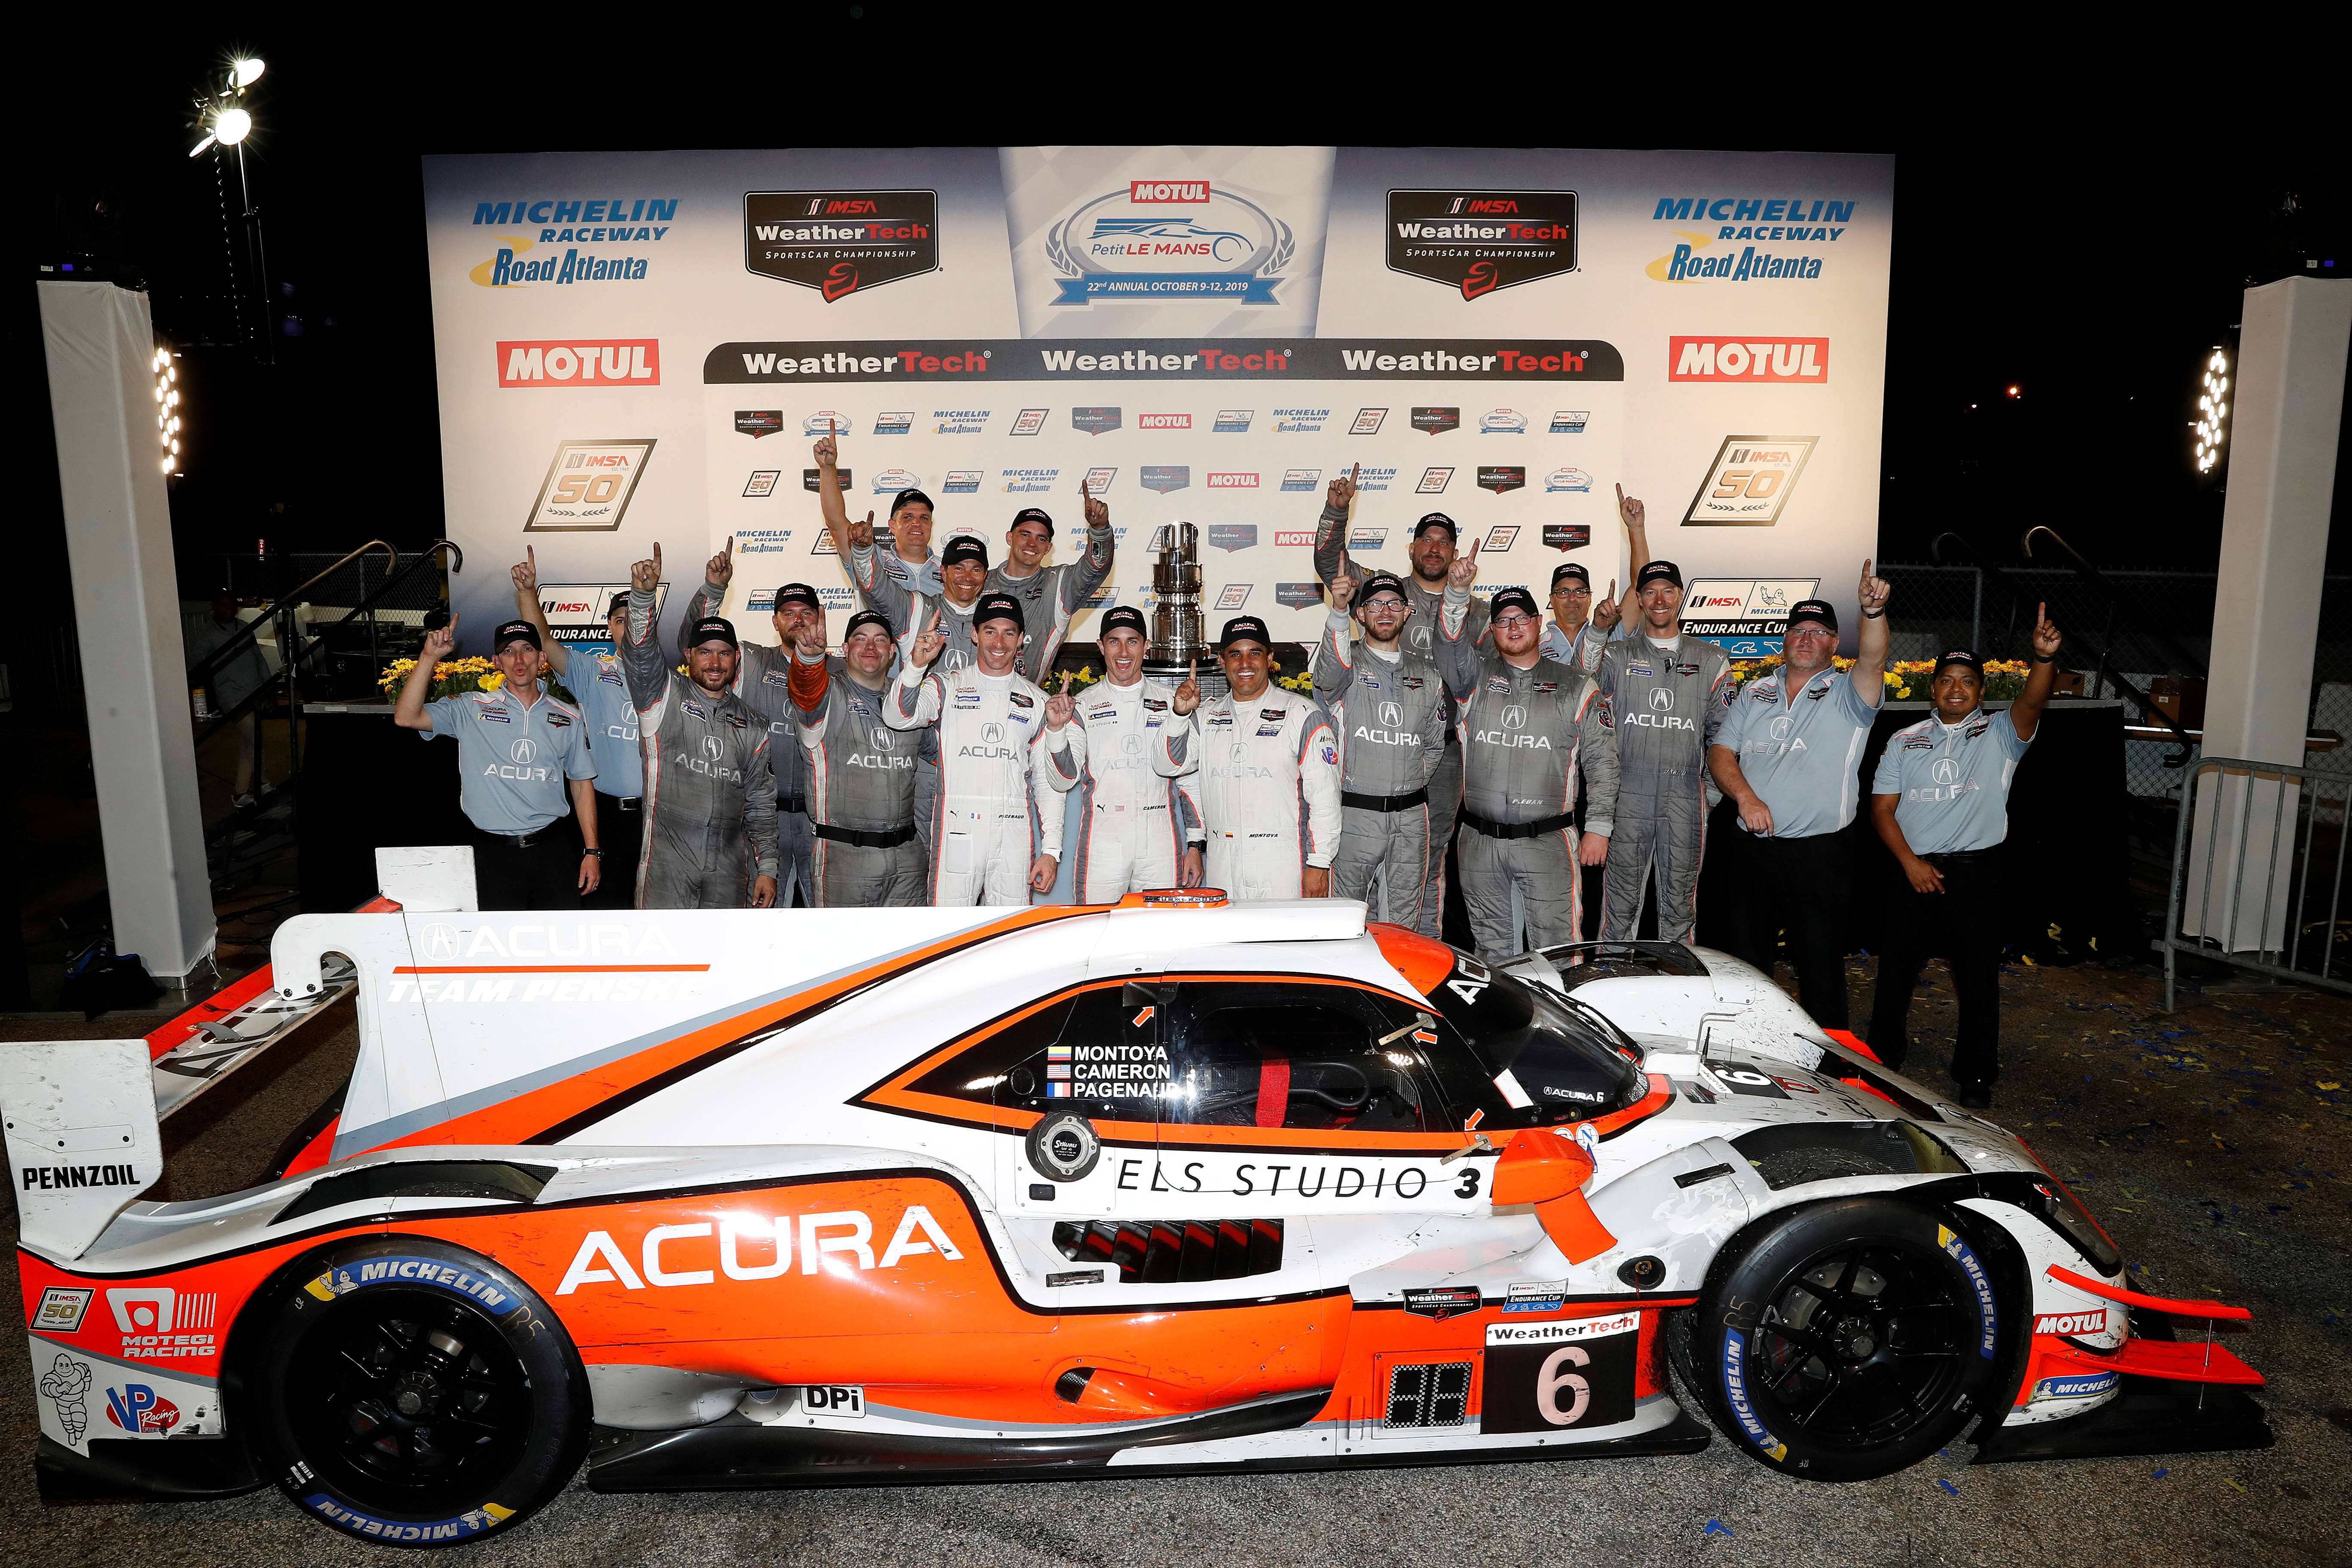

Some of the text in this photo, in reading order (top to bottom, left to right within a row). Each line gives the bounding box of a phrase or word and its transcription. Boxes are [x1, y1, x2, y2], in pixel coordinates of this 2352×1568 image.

[1134, 184, 1206, 200] MOTUL
[472, 199, 679, 225] MICHELIN
[826, 200, 877, 214] IMSA
[1468, 201, 1518, 213] IMSA
[1653, 198, 1855, 222] MICHELIN
[539, 227, 669, 242] RACEWAY
[1718, 227, 1845, 241] RACEWAY
[1092, 243, 1210, 255] Petit LE MANS
[491, 248, 648, 284] Road Atlanta
[1667, 244, 1822, 281] Road Atlanta
[1087, 281, 1248, 292] 22nd ANNUAL OCTOBER 9-12, 2019
[505, 346, 653, 380] MOTUL
[1676, 343, 1822, 377] MOTUL
[939, 424, 981, 434] Road Atlanta
[1018, 419, 1037, 428] 50
[1142, 416, 1189, 427] MOTUL
[1279, 423, 1320, 432] Road Atlanta
[1358, 418, 1378, 427] 50
[585, 456, 629, 467] IMSA
[1749, 452, 1791, 462] IMSA
[750, 480, 771, 489] 50
[1007, 482, 1050, 492] Road Atlanta
[1087, 478, 1106, 486] 50
[1210, 475, 1256, 486] MOTUL
[1363, 481, 1387, 491] Atlanta
[1424, 477, 1444, 486] 50
[1712, 470, 1785, 498] 50
[551, 474, 623, 503] 50
[1278, 534, 1316, 544] MOTU
[1489, 536, 1510, 545] 50
[741, 543, 783, 553] Road Atlanta
[1223, 593, 1242, 602] 50
[1706, 598, 1741, 606] IMSA
[555, 603, 590, 612] IMSA
[827, 601, 851, 610] Atlanta
[550, 629, 612, 639] DURANCE
[1682, 622, 1762, 634] ENDURANCE
[1624, 713, 1695, 732] ACURA
[1354, 726, 1421, 746] ACURA
[1475, 729, 1552, 750] ACURA
[958, 746, 1020, 761] ACURA
[1740, 738, 1807, 755] ACURA
[675, 753, 741, 784] ACURA
[846, 753, 913, 769] ACURA
[484, 764, 558, 782] ACURA
[1210, 766, 1273, 778] ACURA
[1908, 778, 1980, 802] ACURA
[465, 924, 679, 958] ACURA
[387, 978, 710, 1003] TEAM PENSKE
[1075, 1046, 1168, 1060] MONTOYA
[1075, 1064, 1170, 1079] CAMERON
[1075, 1082, 1181, 1097] PAGENAUD
[1552, 1088, 1604, 1102] ACURA 6
[22, 1164, 141, 1191] PENNZOIL
[1118, 1160, 1204, 1193] ELS
[1233, 1165, 1426, 1198] STUDIO
[554, 1205, 965, 1295] ACURA
[361, 1262, 506, 1307] MICHELIN
[1409, 1293, 1478, 1302] WeatherTech
[1961, 1254, 1994, 1351] MICHELIN
[43, 1304, 78, 1319] 50
[2036, 1312, 2104, 1333] MOTUL
[122, 1335, 213, 1346] MOTEGI
[124, 1346, 215, 1357] RACING
[1537, 1346, 1590, 1425] 6
[1727, 1339, 1763, 1434] MICHELIN
[806, 1386, 859, 1412] DPi
[106, 1384, 156, 1433] VP
[141, 1409, 180, 1427] Racing
[316, 1501, 458, 1540] MICHELIN
